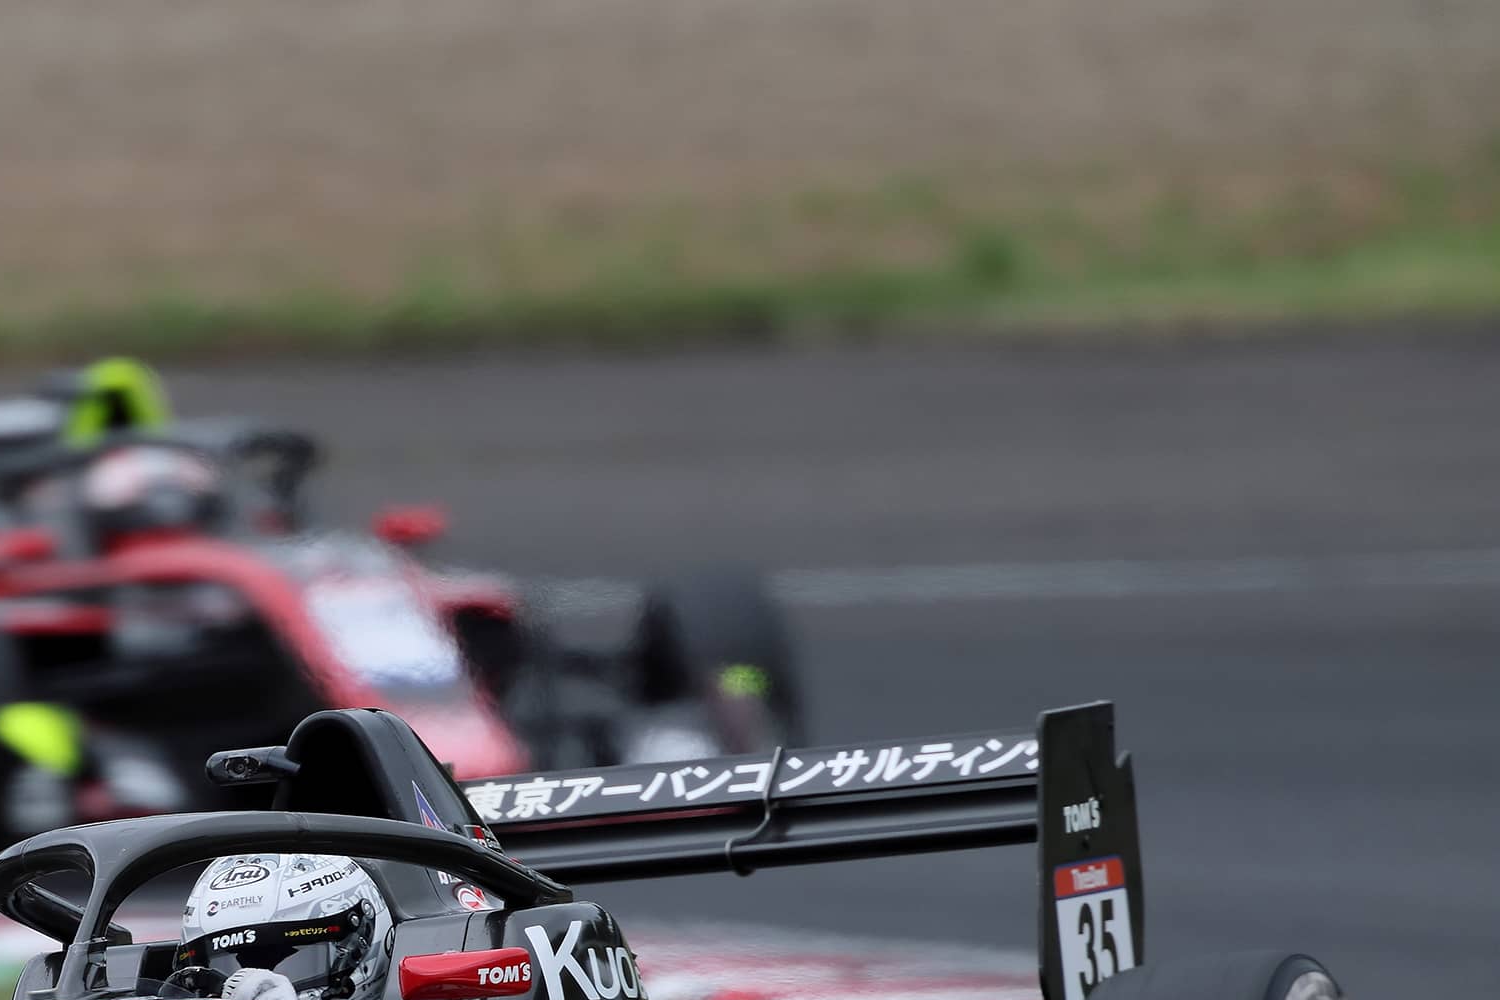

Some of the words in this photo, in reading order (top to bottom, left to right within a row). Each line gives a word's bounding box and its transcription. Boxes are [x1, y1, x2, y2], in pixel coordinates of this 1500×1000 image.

[1063, 797, 1100, 833] TOM'S
[220, 866, 262, 884] Arai
[221, 895, 264, 910] EARTHLY
[212, 929, 256, 950] TOM'S
[1078, 899, 1119, 1000] 35
[478, 962, 531, 985] TOM'S
